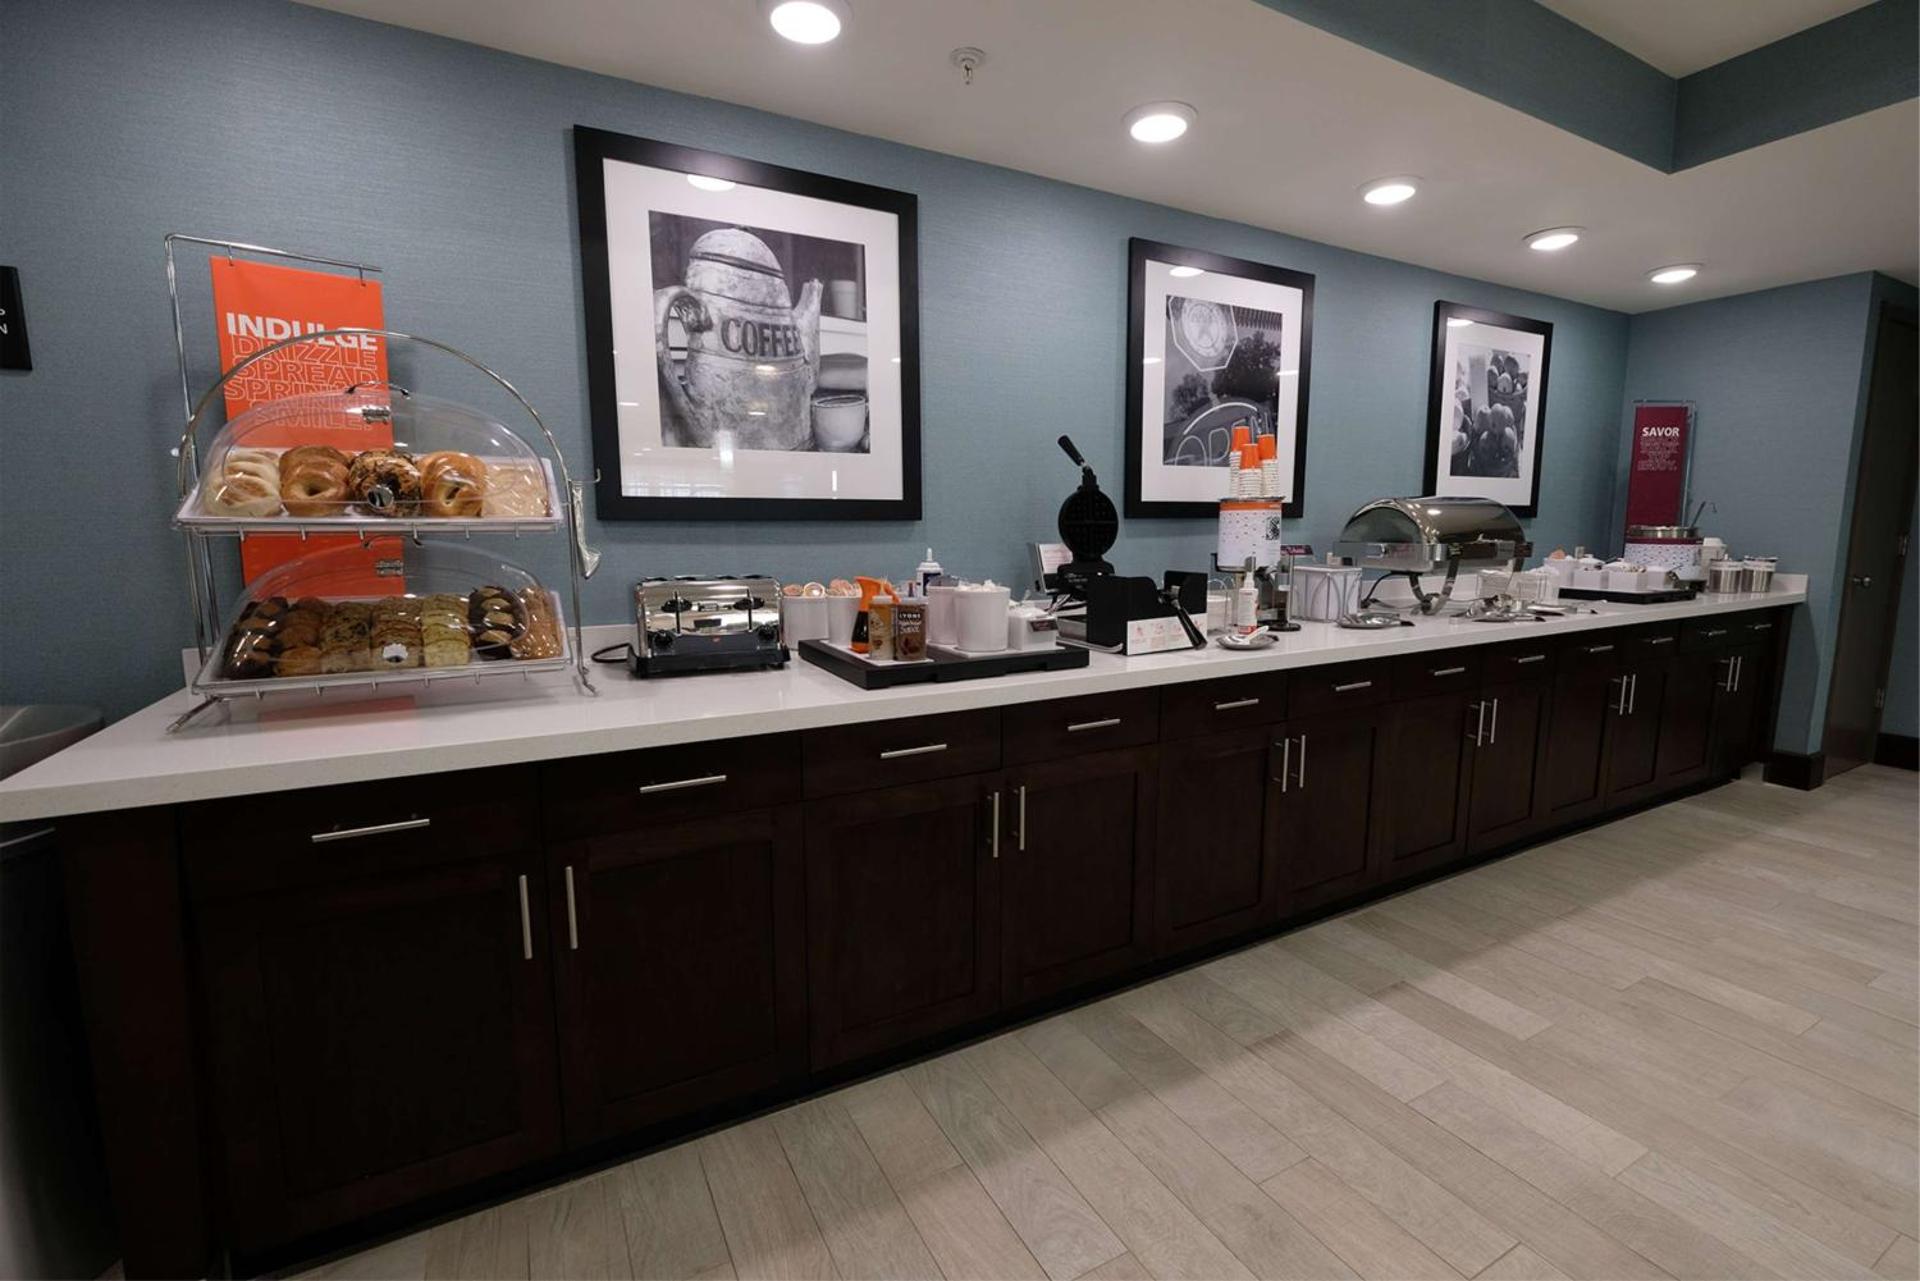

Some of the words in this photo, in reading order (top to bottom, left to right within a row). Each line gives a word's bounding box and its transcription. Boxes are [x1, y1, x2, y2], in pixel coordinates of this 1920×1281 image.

[226, 312, 378, 351] INDULGE
[720, 318, 802, 357] COFFEE
[233, 355, 379, 390] SPREAD
[1641, 427, 1680, 437] SAVOR
